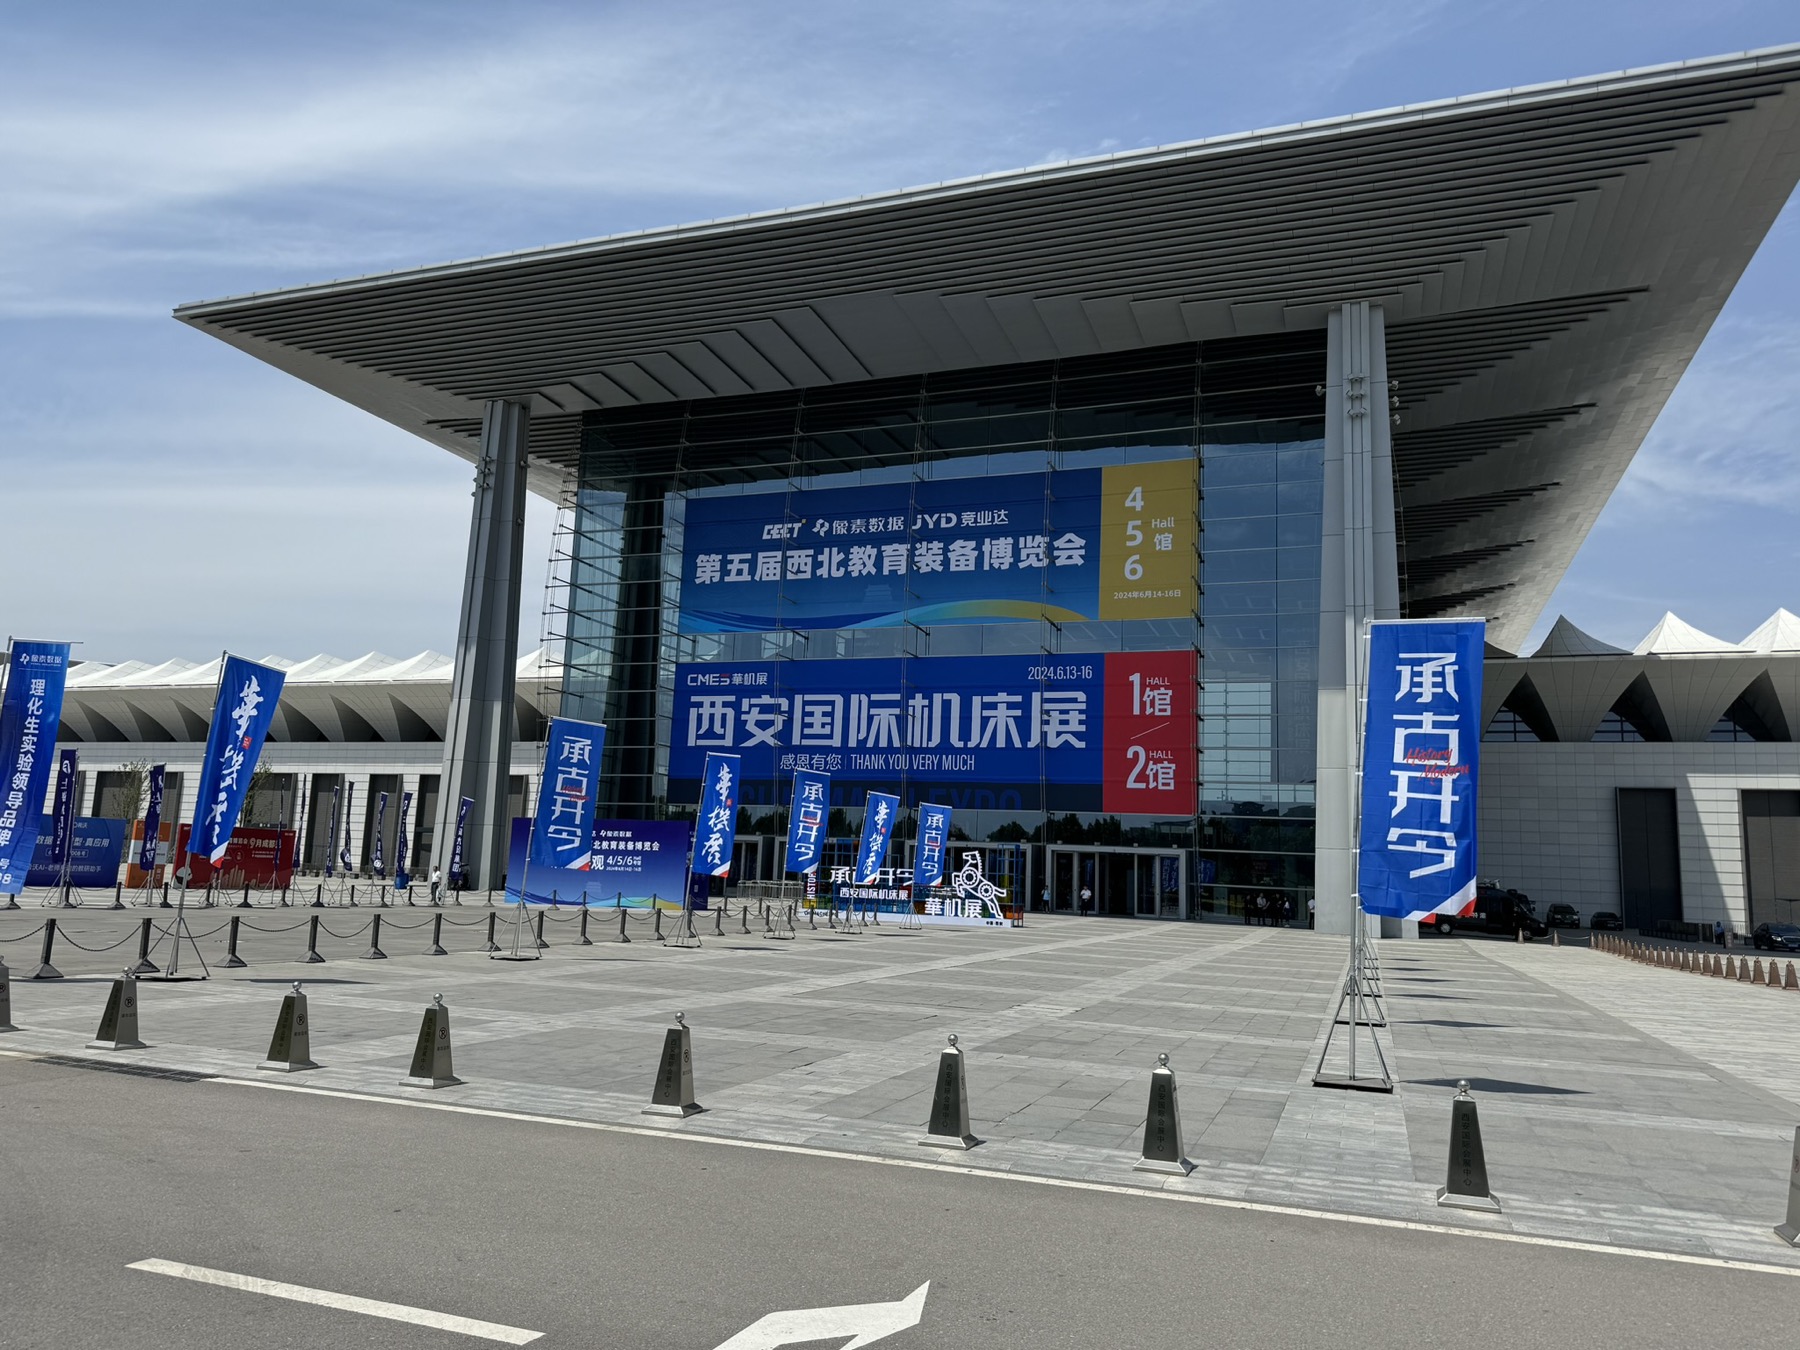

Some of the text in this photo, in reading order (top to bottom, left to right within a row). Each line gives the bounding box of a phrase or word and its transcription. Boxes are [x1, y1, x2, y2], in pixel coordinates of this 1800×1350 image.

[1125, 486, 1144, 512] 4
[833, 516, 904, 535] 像素数据
[912, 513, 957, 530] JYD
[961, 509, 1009, 527] 竞业达
[1151, 517, 1175, 528] Hall
[1126, 520, 1144, 547] 5
[1154, 533, 1173, 551] 馆
[694, 532, 1087, 584] 第五届西北教育装备博览会
[1124, 554, 1143, 580] 6
[1114, 589, 1181, 599] 2024年6月14-16日
[687, 674, 730, 686] CMES
[731, 672, 768, 686] 華机展
[1028, 665, 1093, 680] 2024.6.13-16
[1146, 677, 1170, 685] HALL
[1129, 673, 1141, 715] 1
[1143, 687, 1172, 716] 馆
[687, 691, 1087, 750] 西安国际机床展
[780, 753, 841, 770] 感恩有您
[851, 754, 975, 770] THANK YOU VERY MUCH
[1126, 745, 1147, 789] 2
[1146, 761, 1176, 790] 馆
[591, 840, 660, 851] 北教育装备博览会
[606, 855, 633, 866] 4/5/6
[830, 865, 914, 887] 承开今
[840, 887, 909, 900] 西安国际机床展
[925, 897, 982, 918] 華机展
